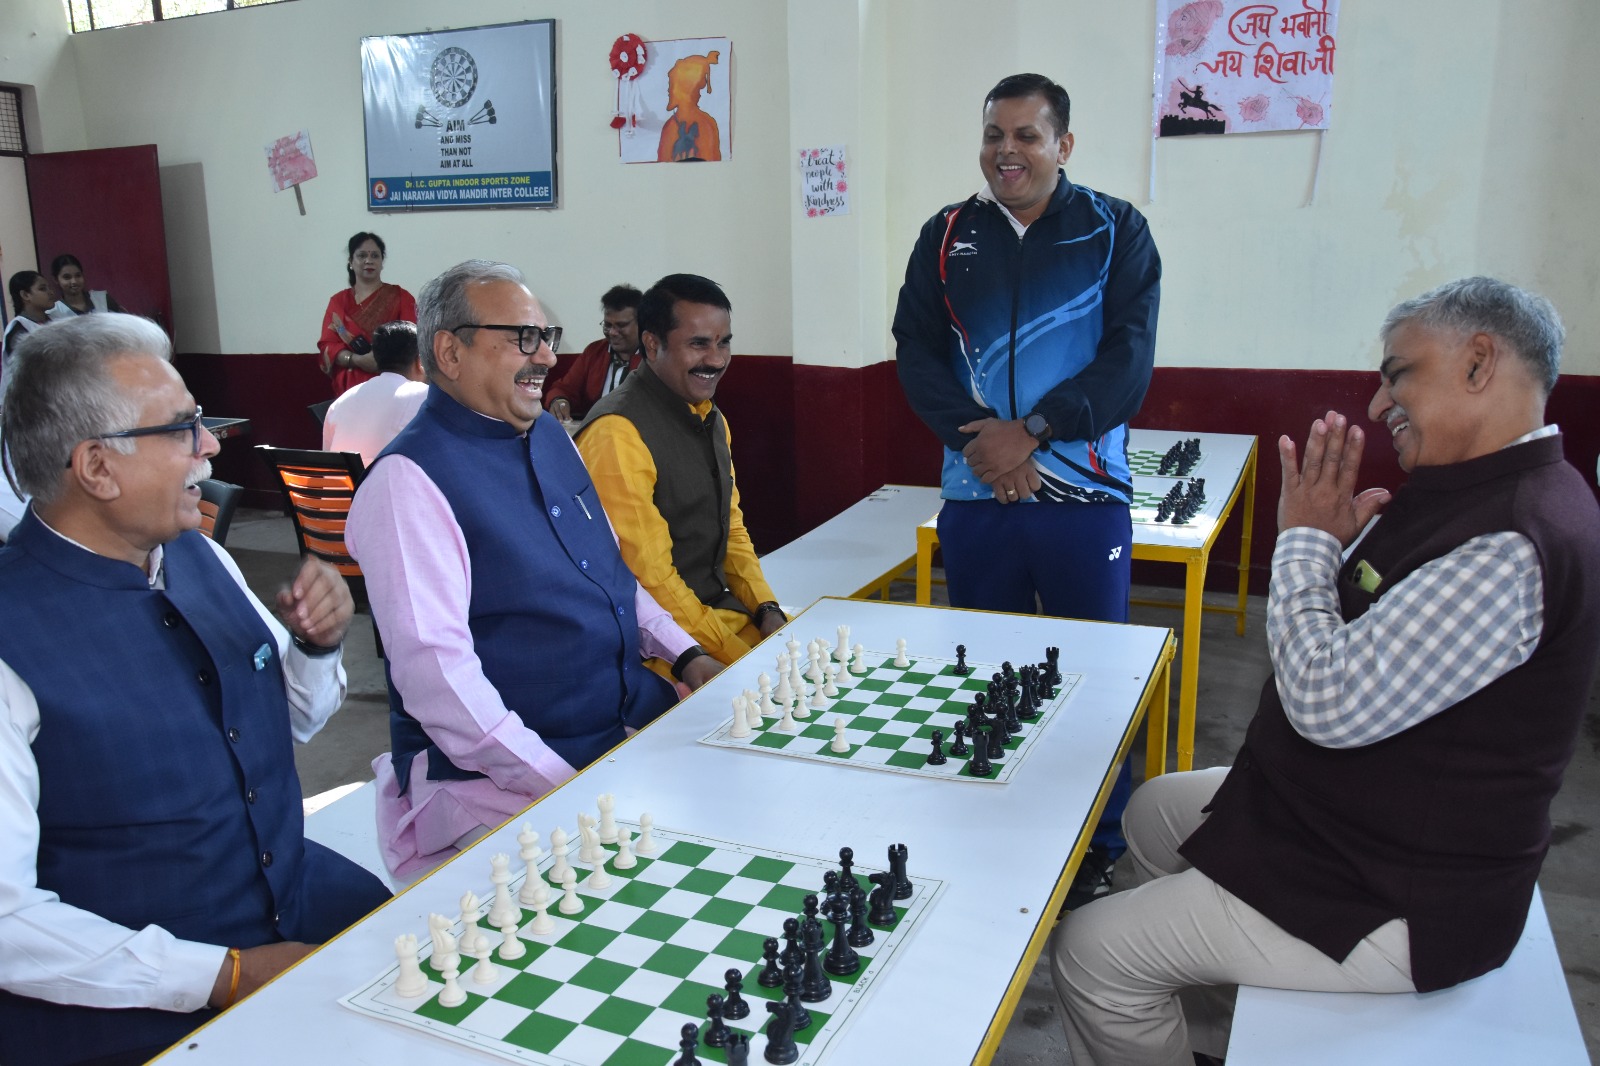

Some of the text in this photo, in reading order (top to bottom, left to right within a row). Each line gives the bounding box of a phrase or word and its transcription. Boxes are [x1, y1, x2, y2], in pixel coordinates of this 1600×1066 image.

[1228, 5, 1279, 46] जय
[1197, 35, 1337, 84] जय शिवाजी
[446, 119, 465, 132] AIM
[455, 134, 472, 143] MISS
[441, 147, 472, 156] THAN NOT
[440, 159, 473, 169] AIM AT ALL
[428, 178, 451, 187] GUPTA
[452, 177, 479, 187] INDOOR
[481, 176, 509, 186] SPORTS
[510, 176, 530, 184] ZONE
[811, 178, 833, 192] with
[390, 186, 549, 201] JAI NARAYAN VIDYA MANDIR INTER COLLEGE
